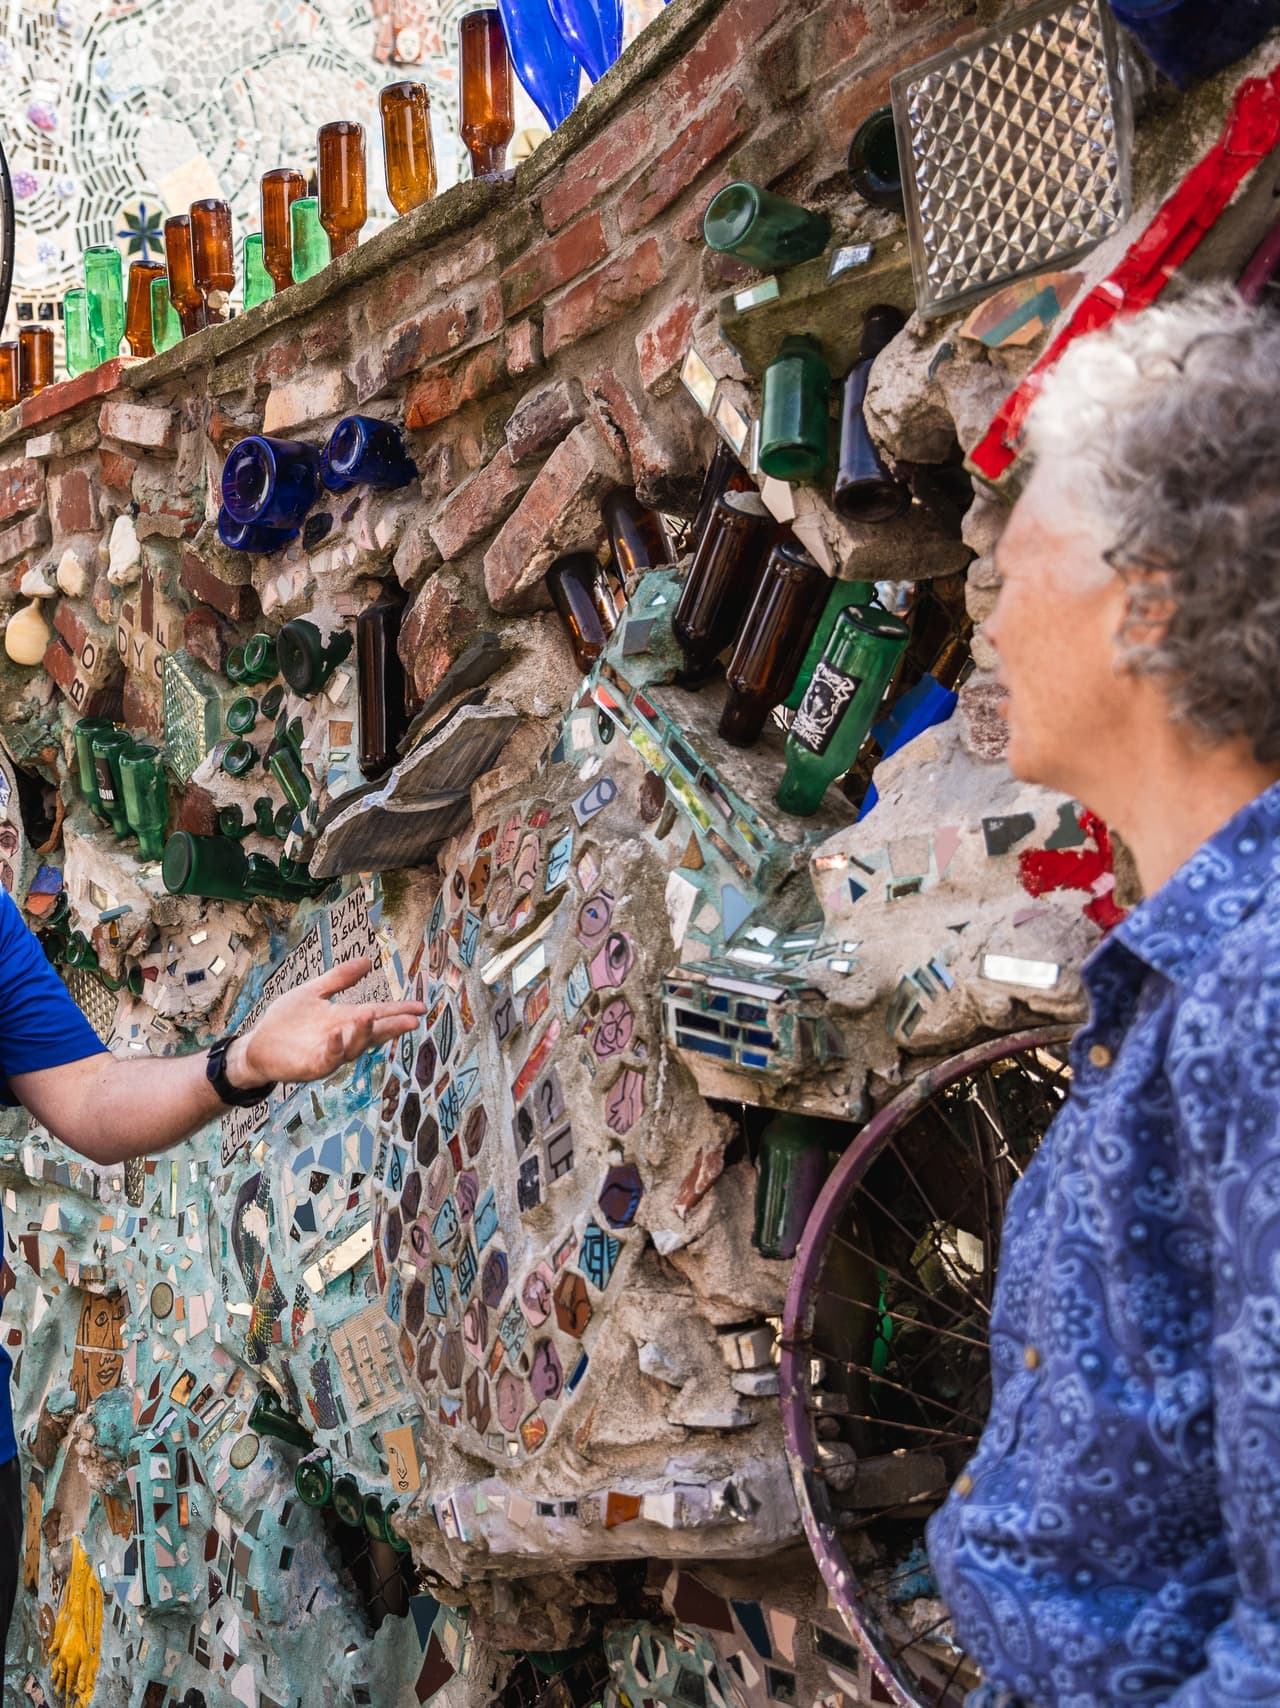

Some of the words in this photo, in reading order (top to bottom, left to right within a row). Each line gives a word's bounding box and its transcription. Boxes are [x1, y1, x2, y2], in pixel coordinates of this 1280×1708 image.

[330, 907, 345, 928] by
[331, 933, 338, 947] a
[341, 906, 369, 940] subj
[275, 924, 318, 994] portrayed
[310, 950, 323, 968] to
[230, 1100, 269, 1148] timeless
